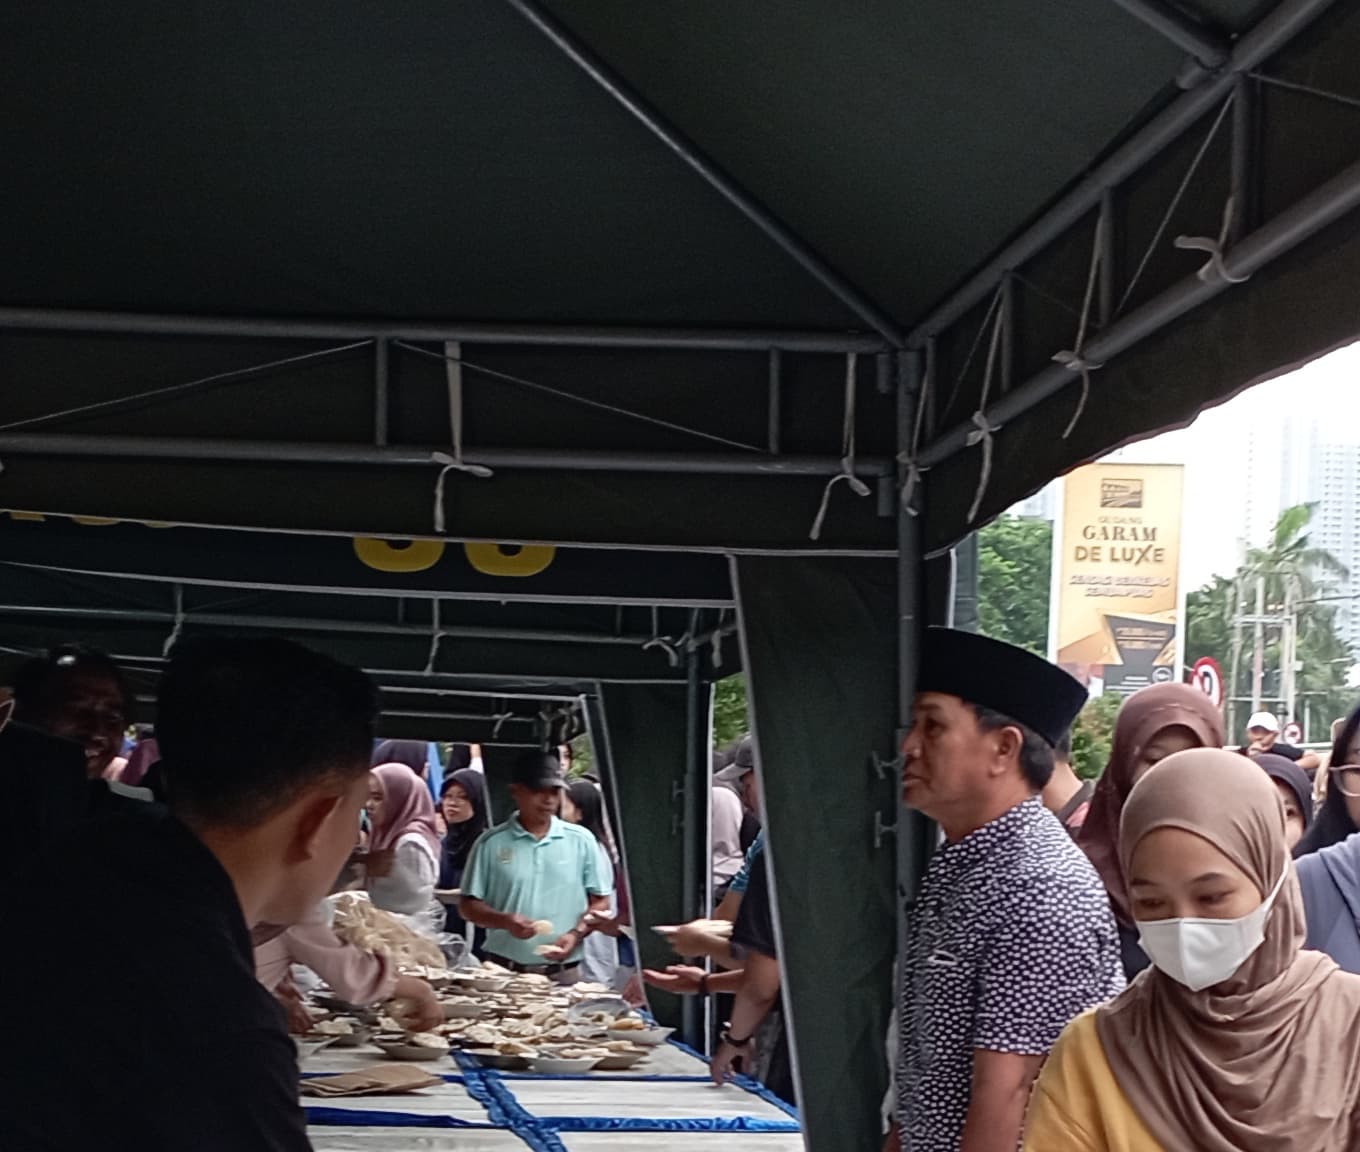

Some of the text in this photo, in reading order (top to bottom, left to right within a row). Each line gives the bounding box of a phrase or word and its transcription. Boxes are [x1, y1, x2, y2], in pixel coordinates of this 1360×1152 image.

[1082, 525, 1157, 541] GARAM
[1074, 544, 1165, 565] DE LUXE
